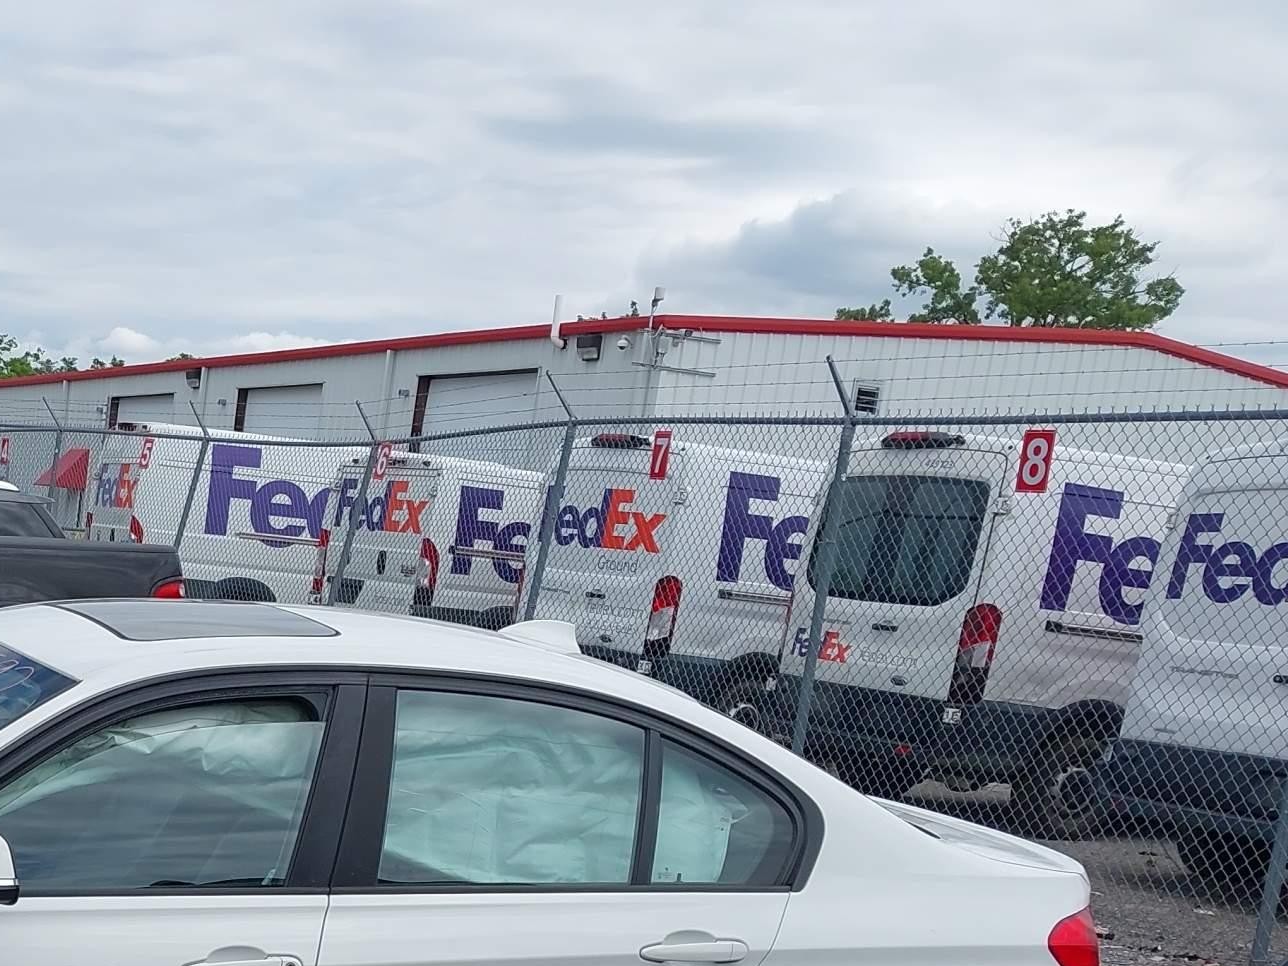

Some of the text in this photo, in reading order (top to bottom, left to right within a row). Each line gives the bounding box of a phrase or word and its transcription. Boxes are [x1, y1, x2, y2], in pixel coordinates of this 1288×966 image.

[141, 441, 153, 466] 5
[377, 445, 391, 476] 6
[654, 437, 669, 474] 7
[1023, 437, 1048, 486] 8
[597, 555, 639, 574] Ground
[791, 628, 852, 664] FeEx
